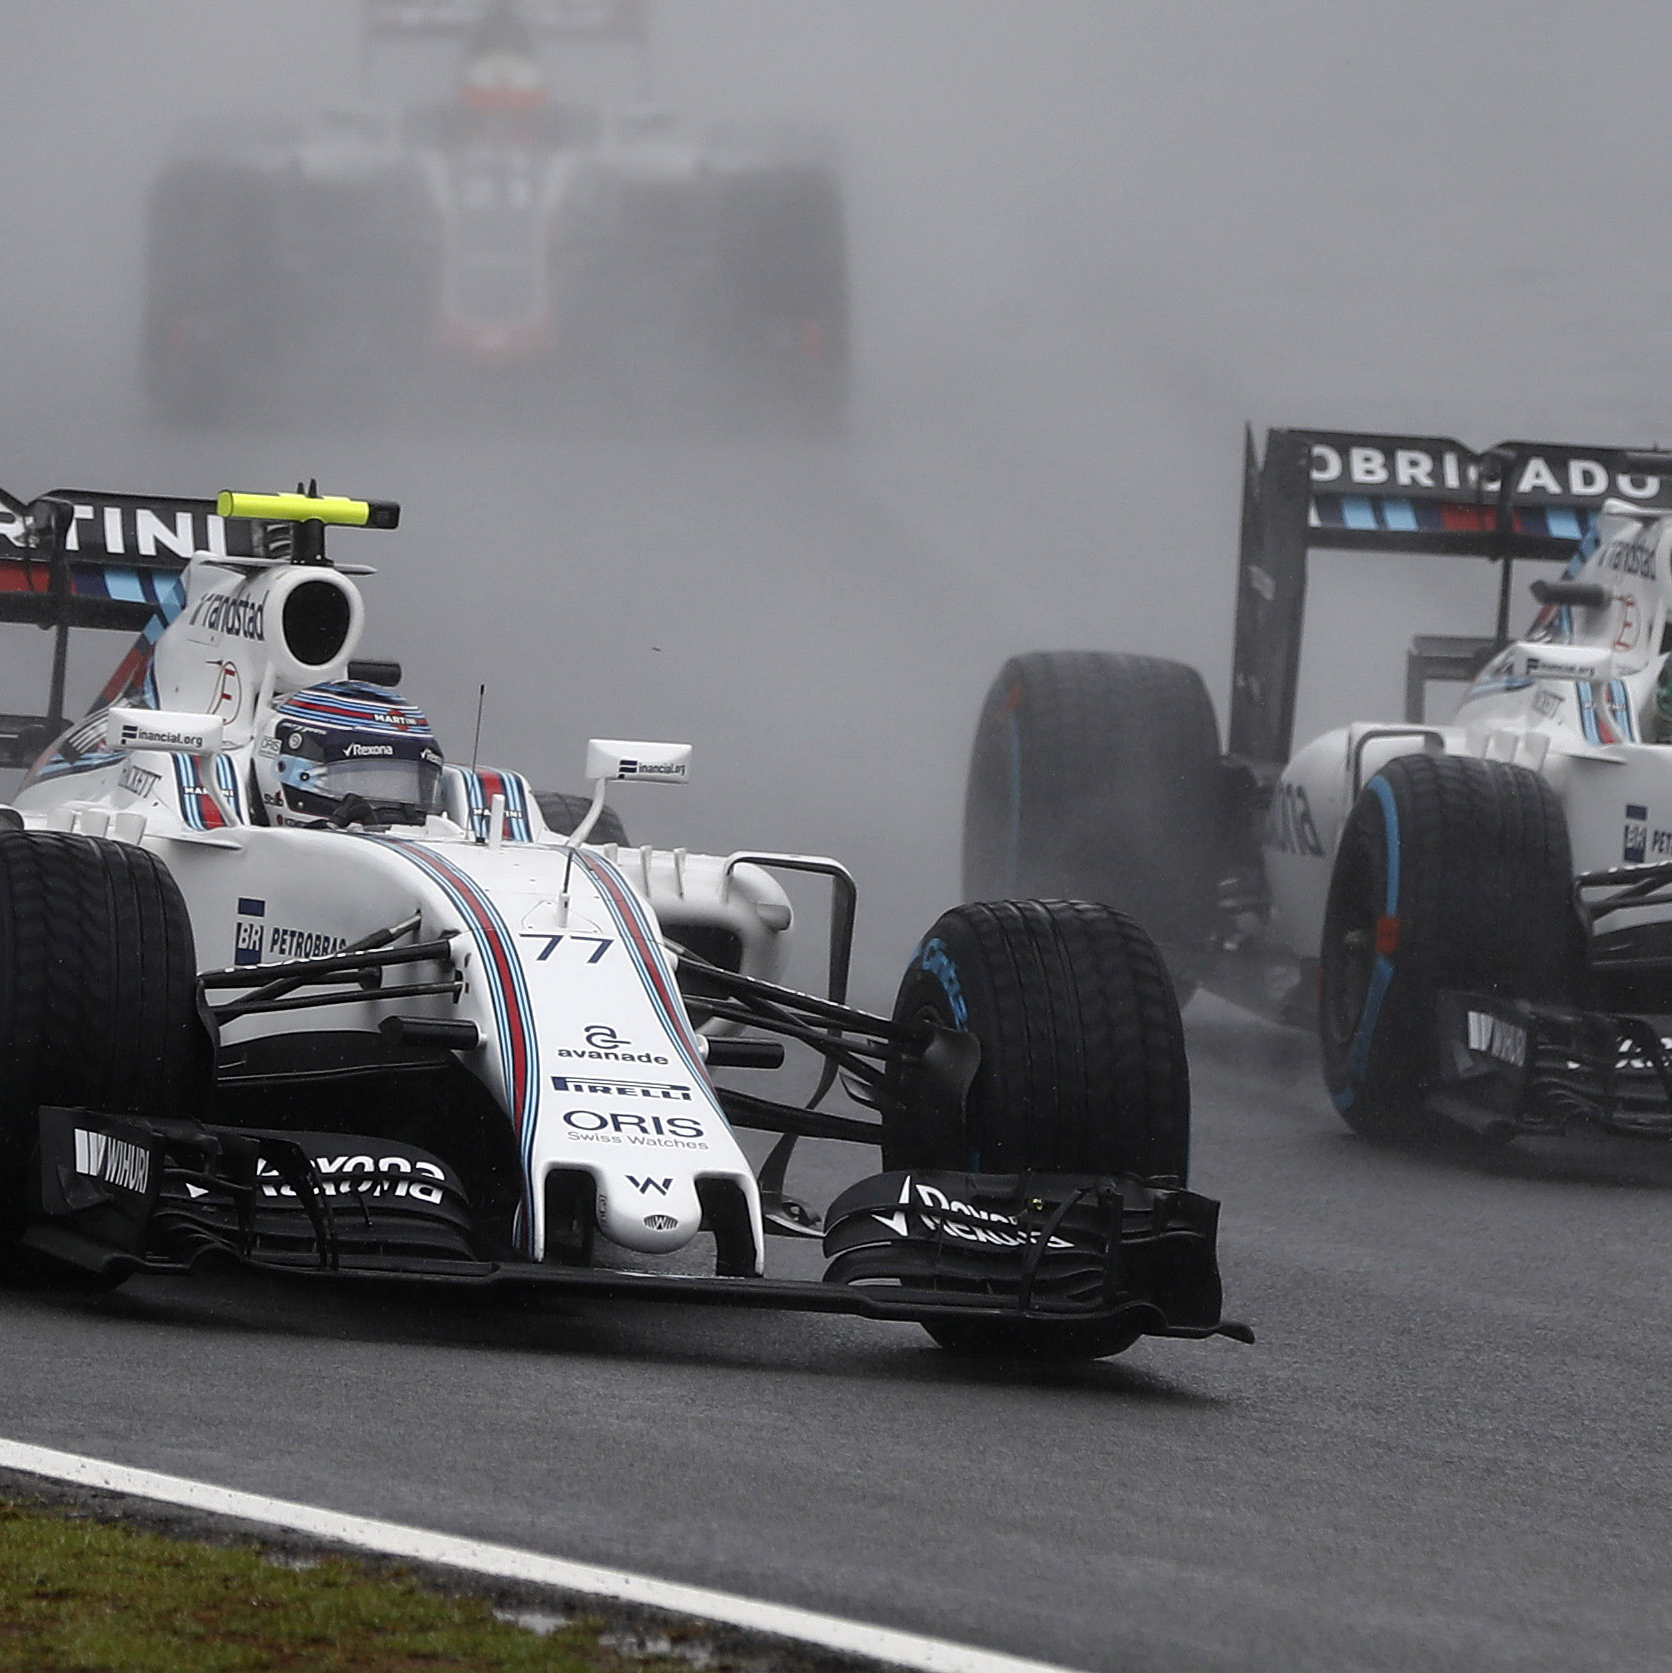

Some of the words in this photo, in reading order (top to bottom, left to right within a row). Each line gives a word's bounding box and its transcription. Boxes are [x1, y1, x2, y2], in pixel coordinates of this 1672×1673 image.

[190, 588, 269, 642] randstad
[374, 714, 418, 726] MARTINI
[353, 743, 394, 756] Rexona
[237, 922, 261, 952] BR
[519, 933, 616, 964] 77
[557, 1049, 669, 1066] avanade
[550, 1076, 692, 1101] PIRELLI
[563, 1110, 704, 1138] ORIS
[567, 1131, 622, 1145] Swiss
[628, 1136, 709, 1151] Watches
[104, 1136, 150, 1195] WIHURI
